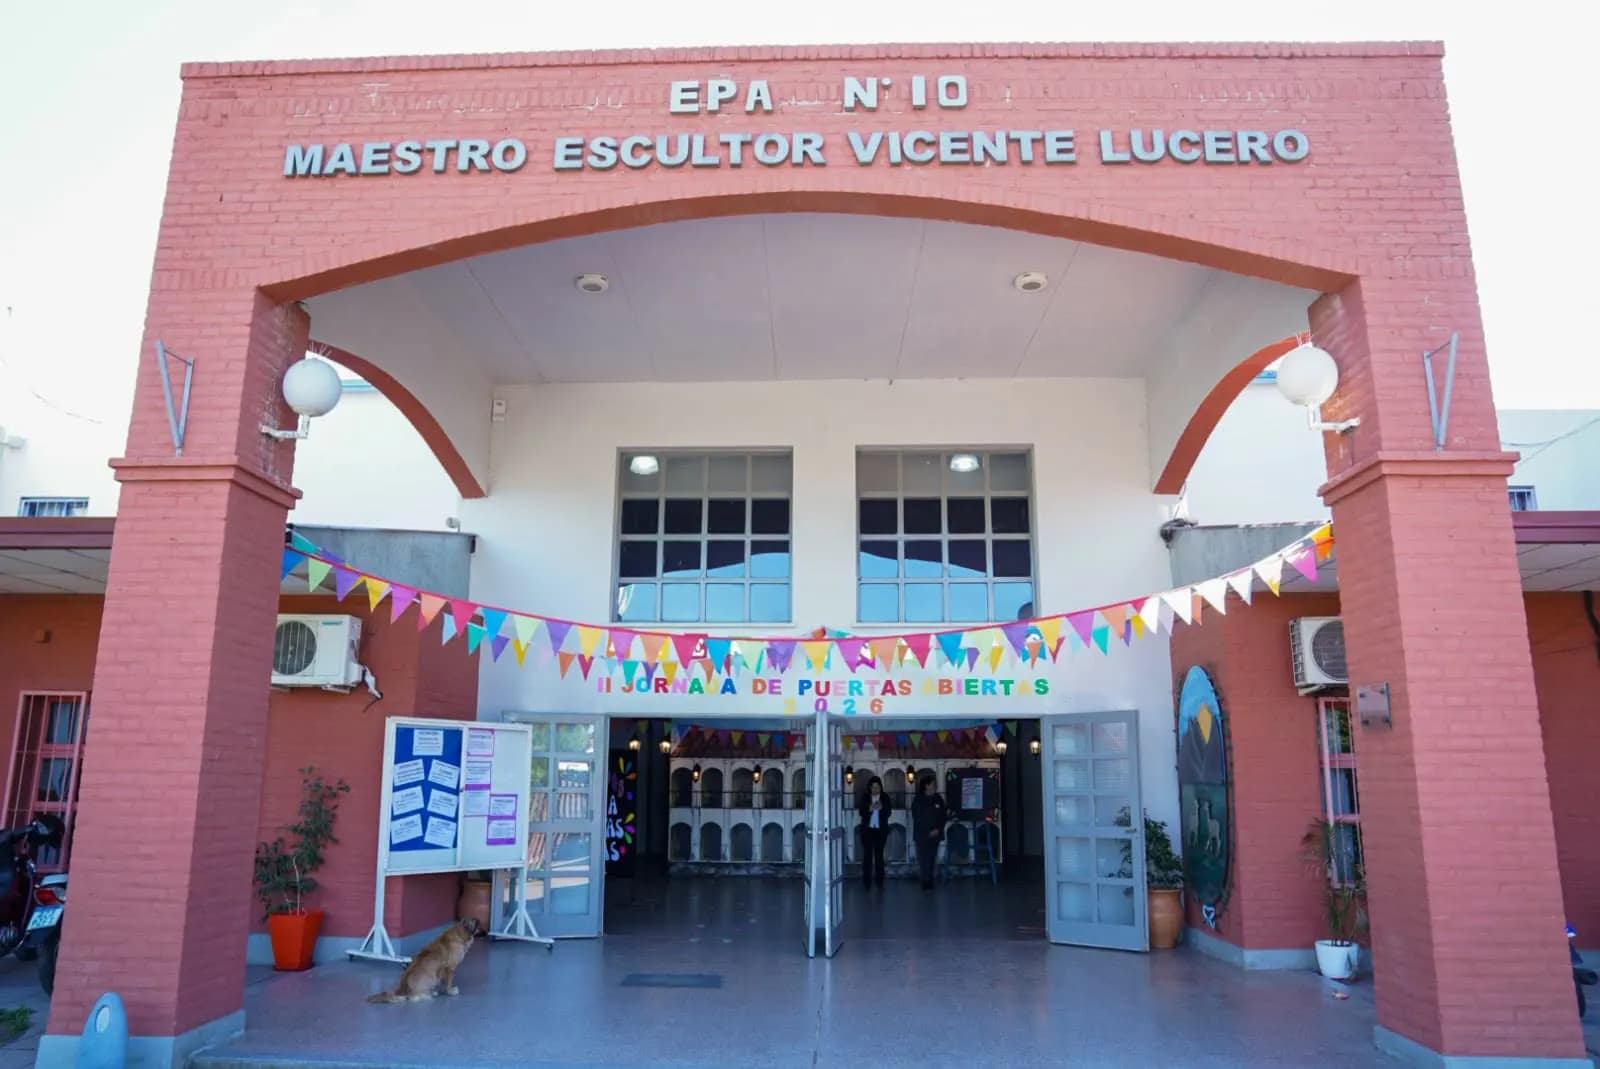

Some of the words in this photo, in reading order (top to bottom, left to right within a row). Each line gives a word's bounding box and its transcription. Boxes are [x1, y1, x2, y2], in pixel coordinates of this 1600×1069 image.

[669, 79, 774, 114] EPA
[911, 73, 968, 109] 10
[283, 138, 527, 177] MAESTRO
[553, 132, 826, 170] ESCULTOR
[847, 130, 1076, 165] VICENTE
[1099, 128, 1310, 164] LUCERO
[752, 678, 782, 695] DE
[798, 679, 912, 697] PUERTAS
[920, 678, 1049, 696] ABIERTAS
